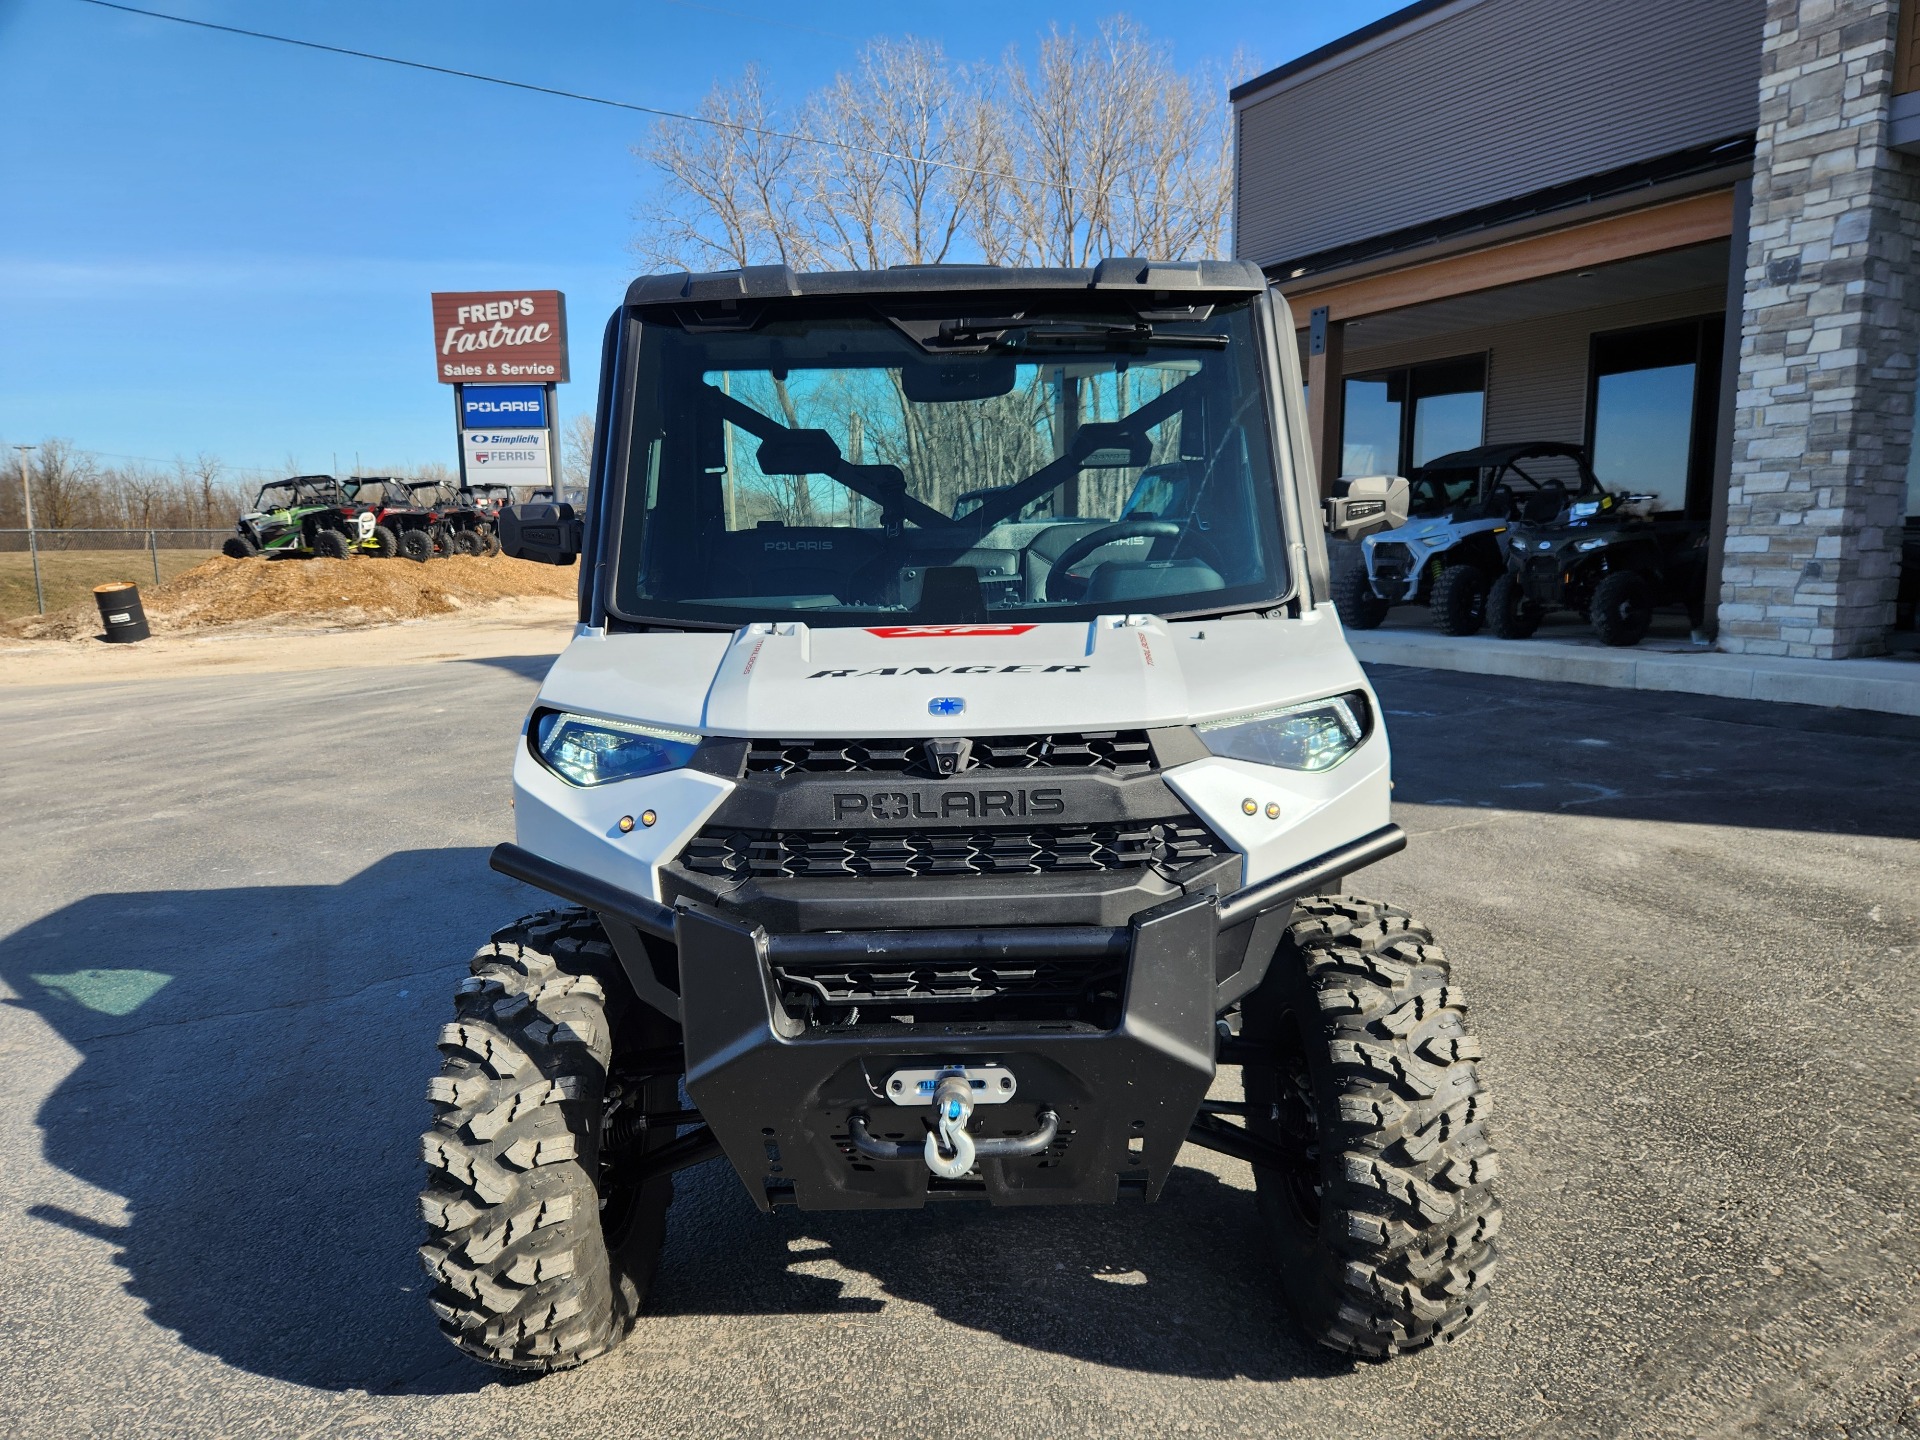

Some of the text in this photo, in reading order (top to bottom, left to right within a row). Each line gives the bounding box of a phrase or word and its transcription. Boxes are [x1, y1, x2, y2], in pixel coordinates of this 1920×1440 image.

[457, 297, 535, 325] FRED'S
[442, 321, 552, 356] Fastrac
[443, 362, 555, 376] Sales & Service
[466, 401, 541, 413] POLARIS
[491, 434, 540, 446] Simplicity
[490, 451, 536, 461] FERRIS
[764, 541, 833, 551] POLARIS
[805, 665, 1091, 680] RANGER
[832, 788, 1066, 821] POLARIS
